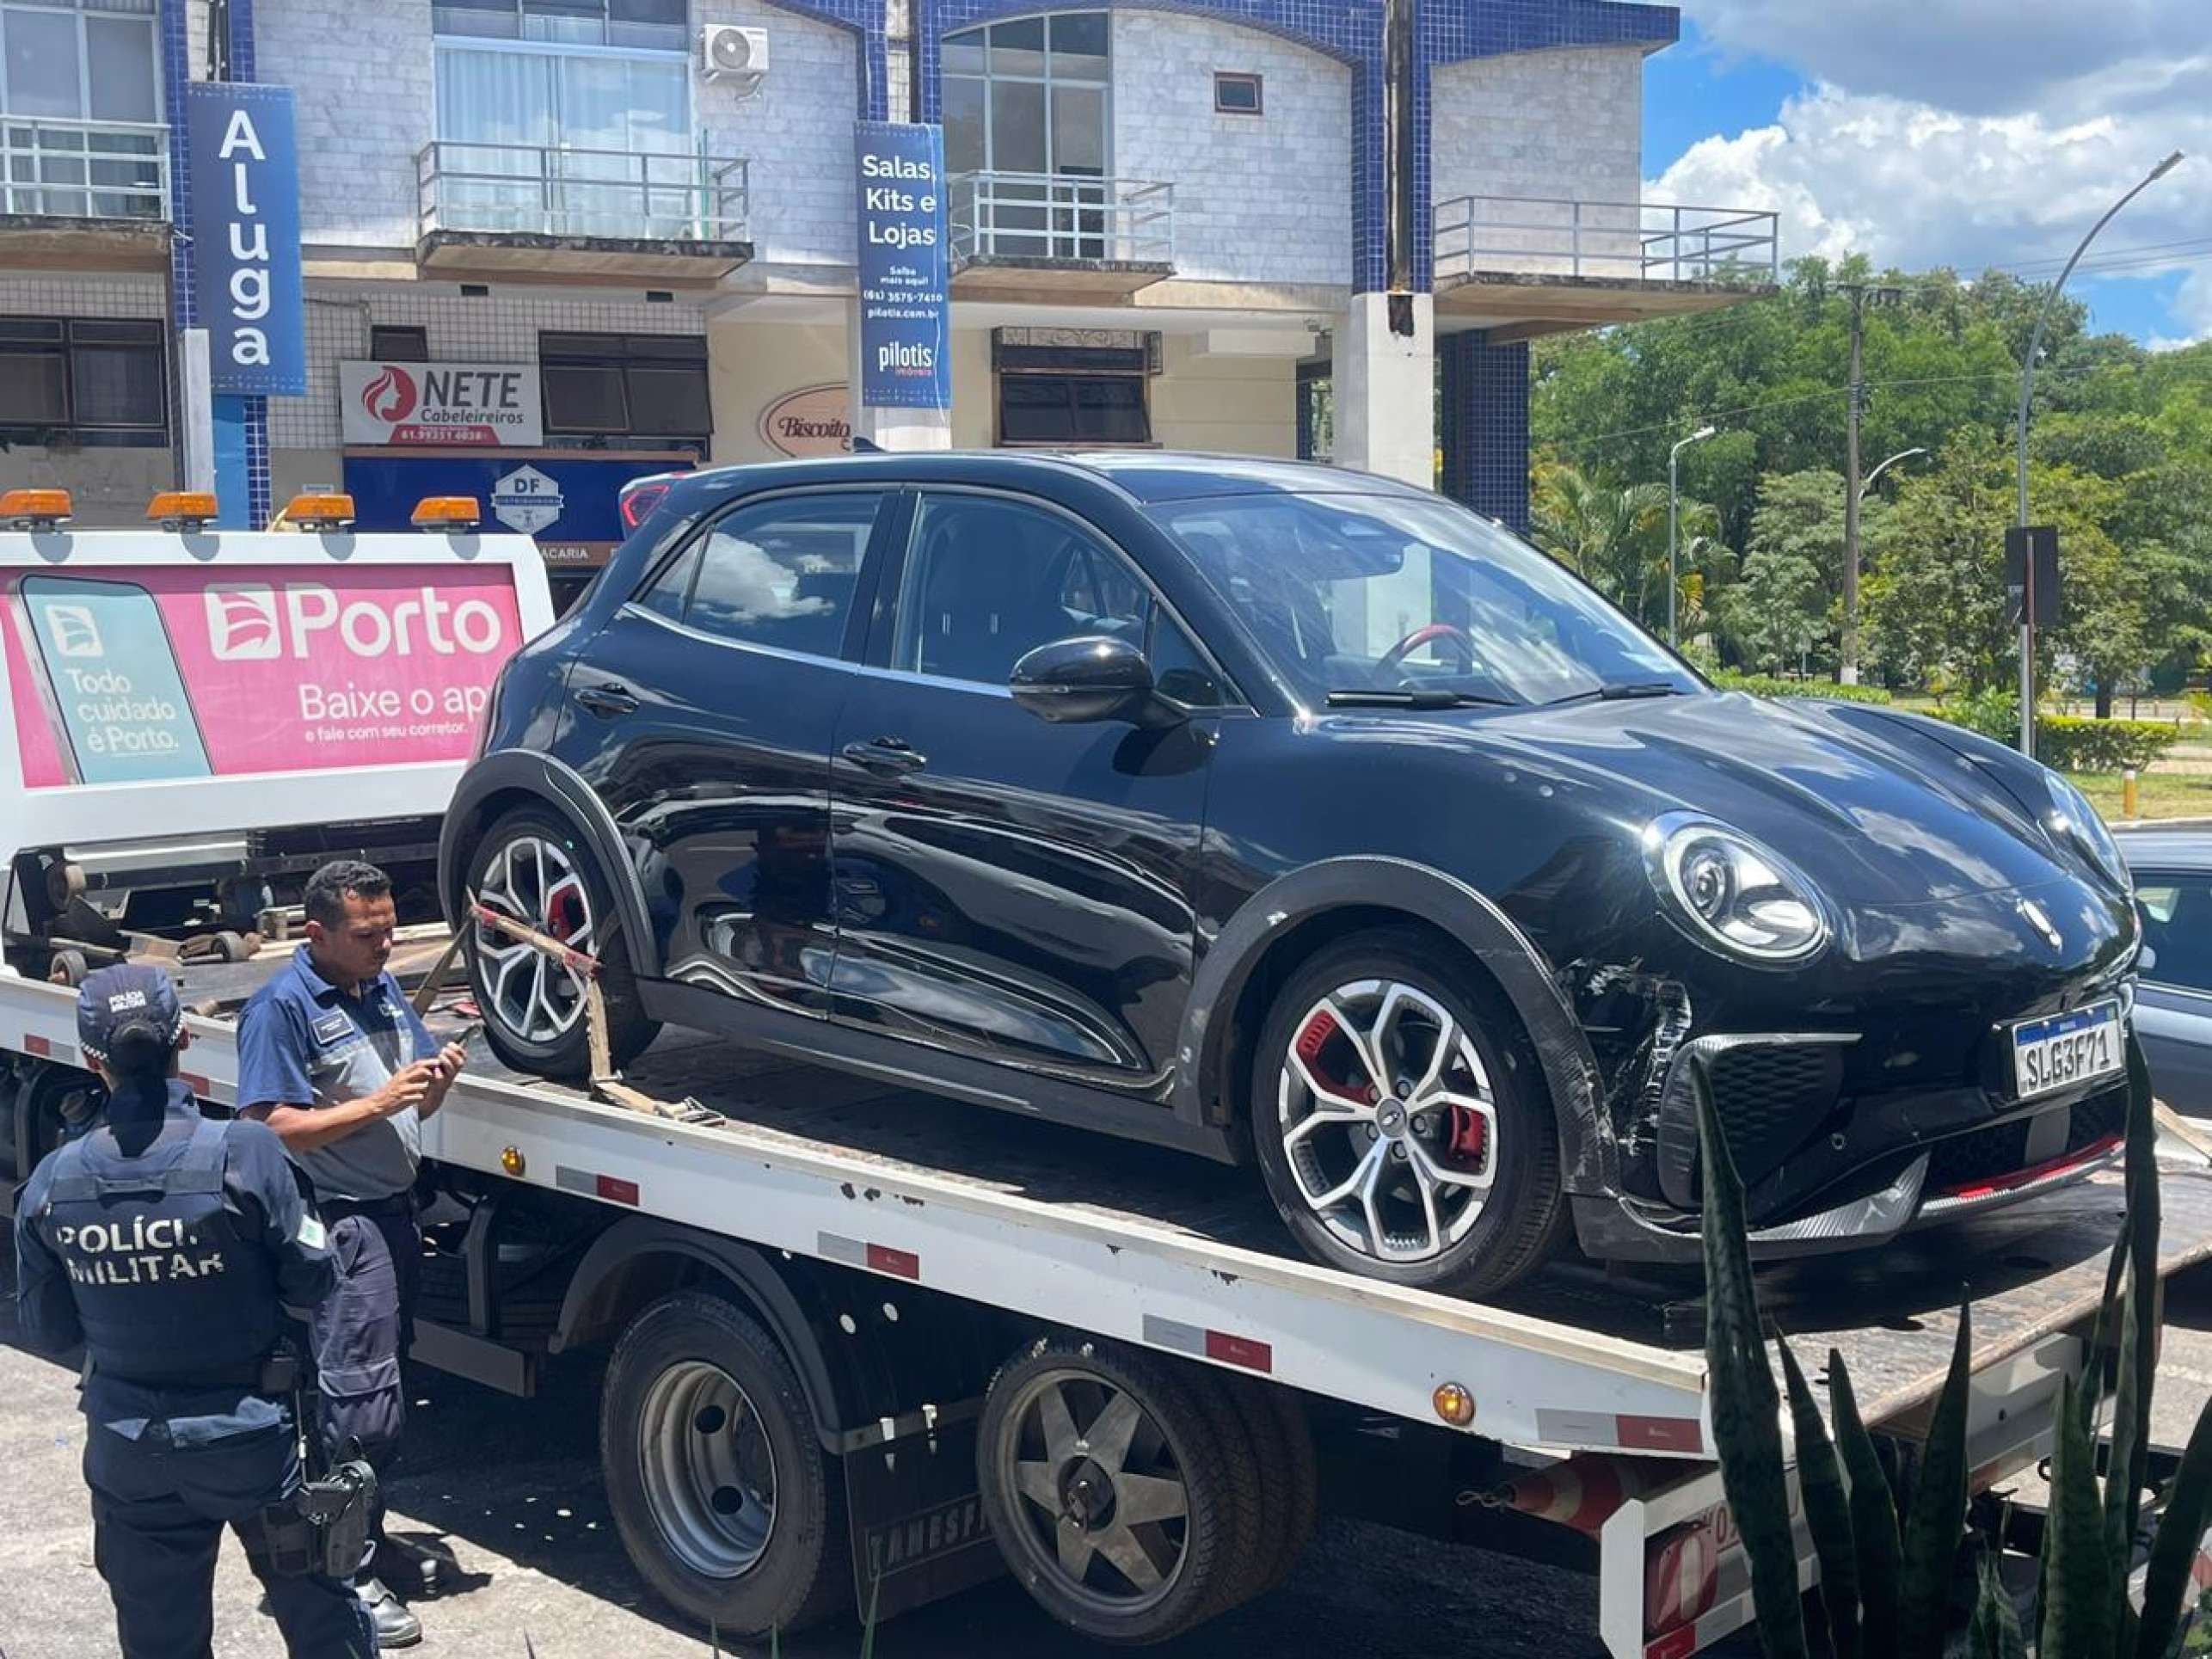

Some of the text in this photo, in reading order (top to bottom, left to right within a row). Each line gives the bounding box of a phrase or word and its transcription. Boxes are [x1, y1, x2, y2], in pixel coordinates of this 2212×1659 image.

[866, 187, 937, 213] Kits e
[219, 110, 270, 366] Aluga
[869, 220, 937, 249] Lojas
[878, 341, 933, 372] pilotis
[422, 371, 522, 409] NETE
[421, 409, 524, 424] Cabeleireiros
[515, 478, 540, 493] DF
[542, 547, 589, 558] ACARIA
[285, 582, 501, 659] Porto
[65, 668, 132, 694] Todo
[77, 697, 176, 722] cuidado
[298, 682, 487, 722] Baixe o ap
[87, 727, 106, 753] é
[305, 730, 316, 742] e
[317, 727, 346, 741] fale
[347, 728, 379, 740] com
[382, 726, 407, 738] seu
[2026, 1029, 2110, 1089] SLG3F71
[57, 1214, 199, 1253] POLÍCI
